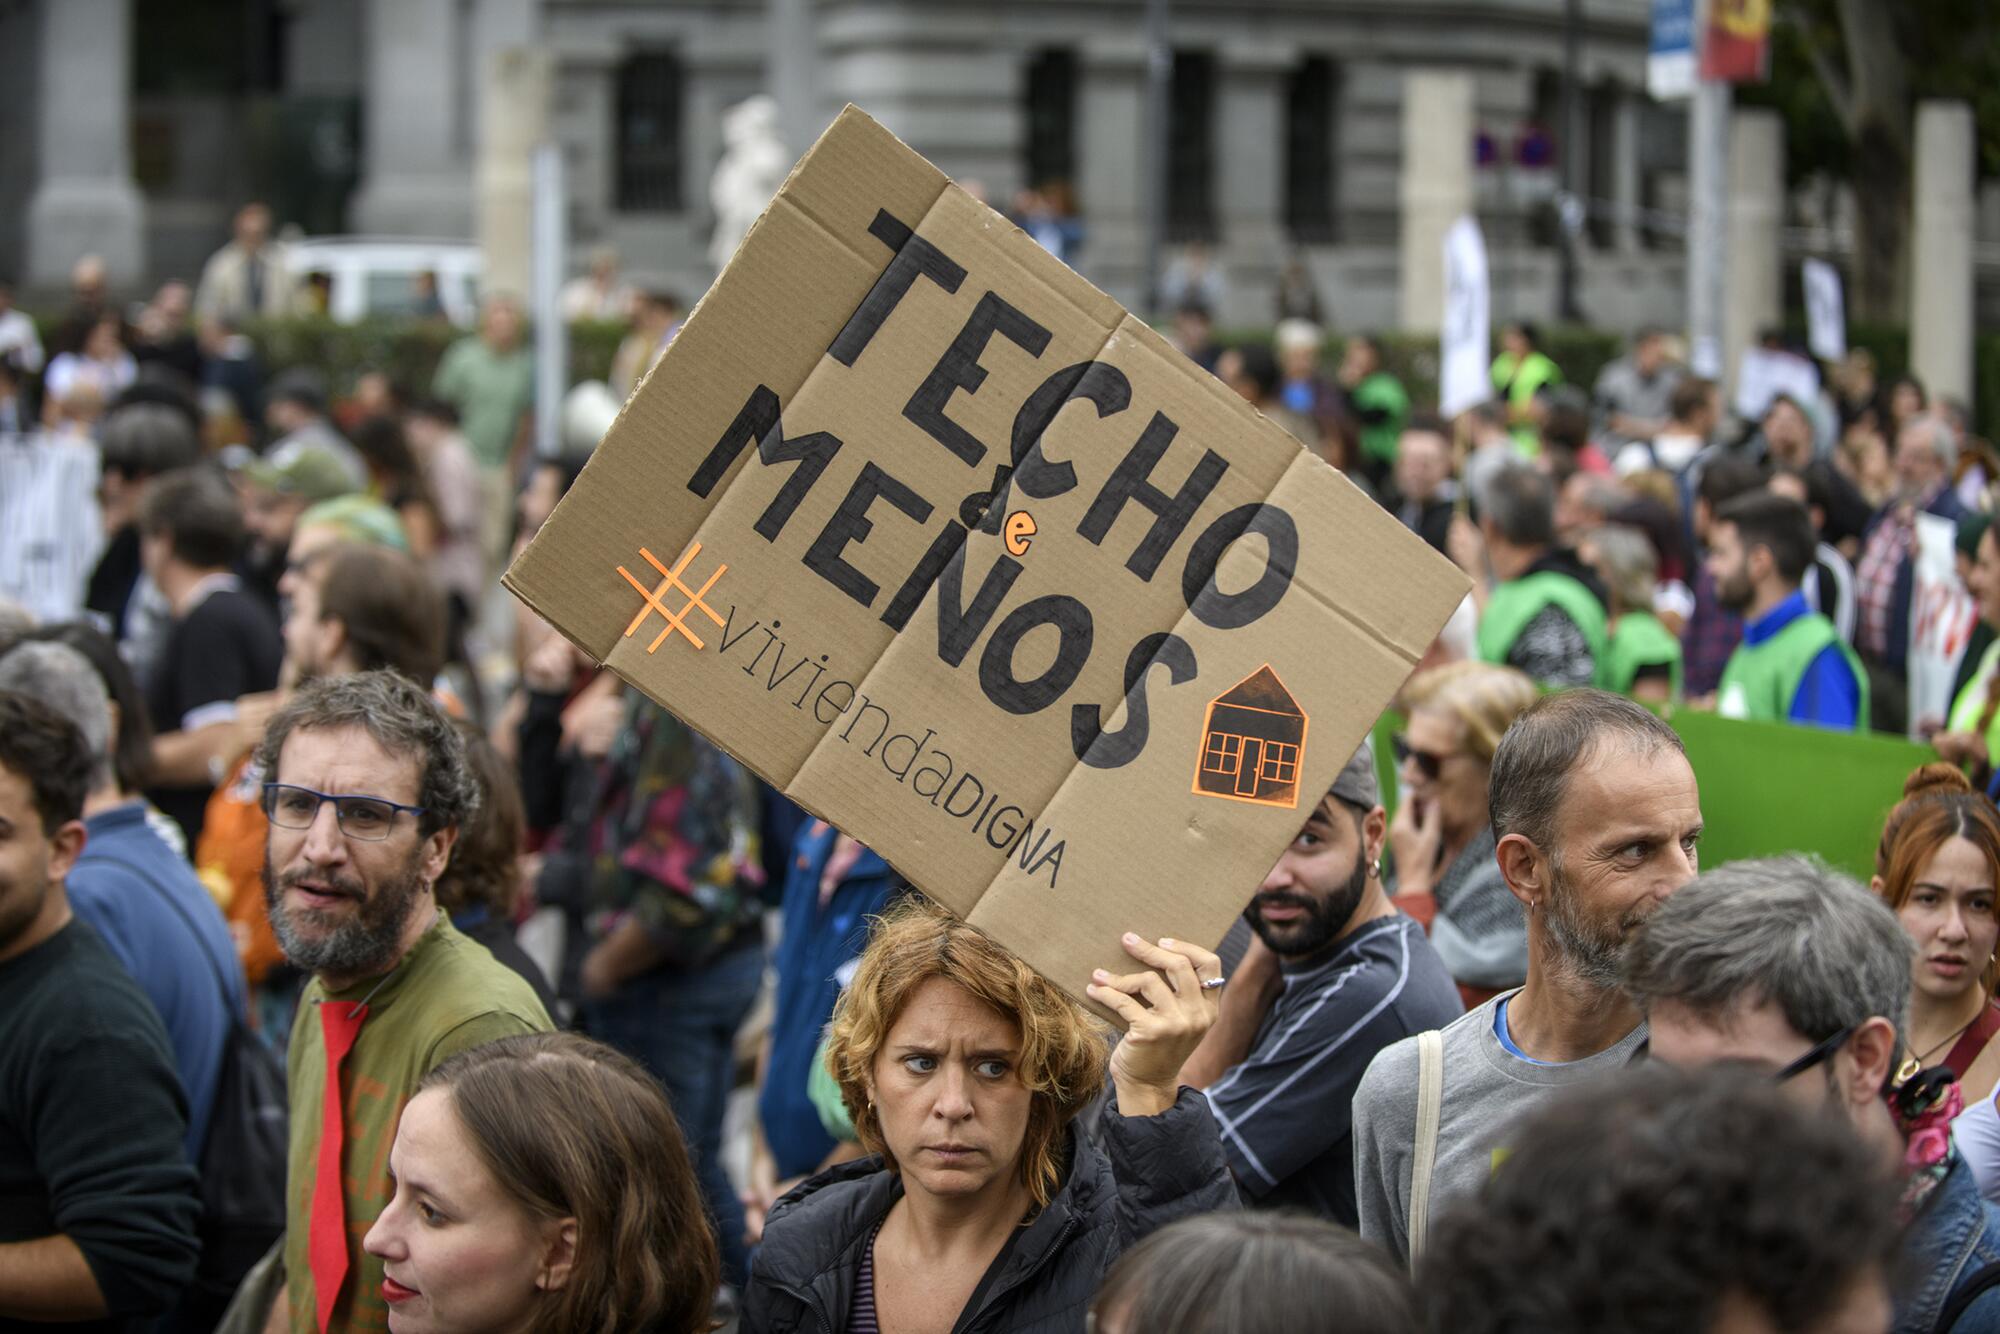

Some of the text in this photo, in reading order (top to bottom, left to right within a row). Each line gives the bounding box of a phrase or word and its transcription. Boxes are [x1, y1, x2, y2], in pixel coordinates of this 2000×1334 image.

[686, 383, 1198, 770] MENOS
[828, 208, 1299, 630] TECHO
[958, 463, 1038, 557] de
